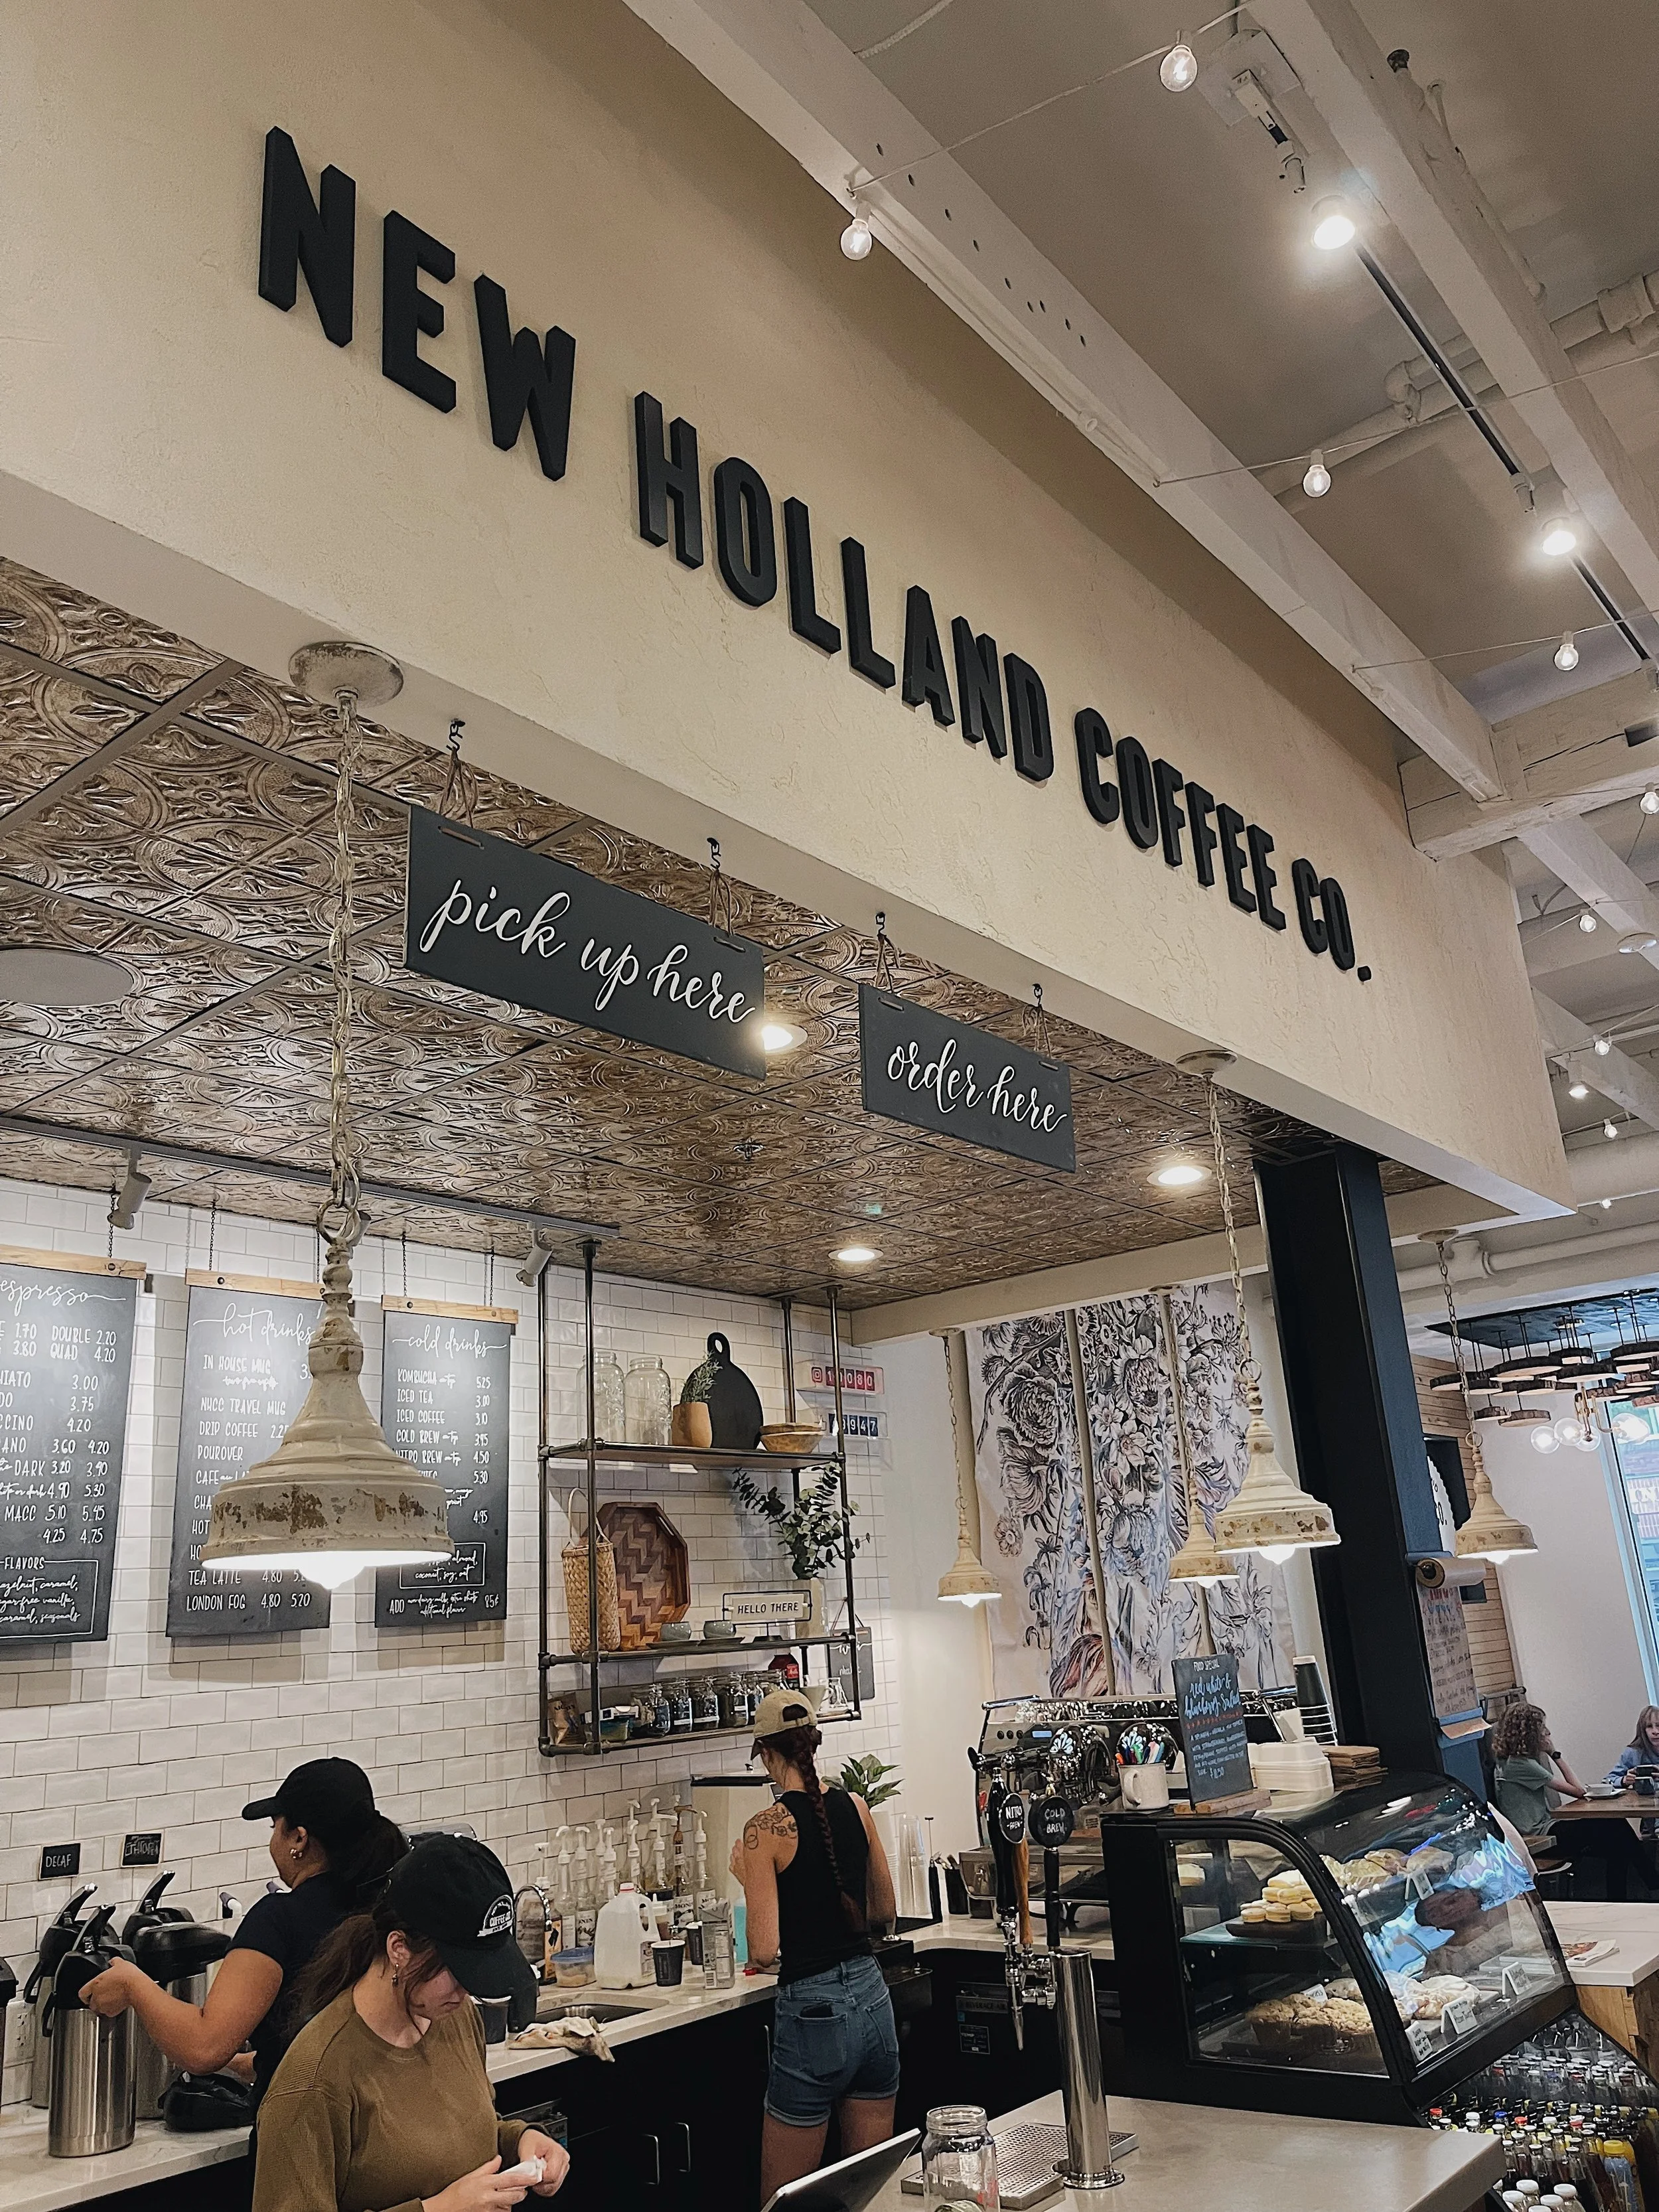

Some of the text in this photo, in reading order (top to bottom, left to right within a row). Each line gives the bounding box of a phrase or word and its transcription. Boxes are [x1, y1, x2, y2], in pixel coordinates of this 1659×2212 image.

[258, 126, 1372, 982] NEW HOLLAND COFFEE CO.
[419, 879, 756, 1023] pick up here
[888, 1039, 1067, 1132] order here
[0, 1280, 126, 1316] espresso
[193, 1302, 316, 1346] hot drinks
[16, 1323, 37, 1339] 1.70
[52, 1325, 91, 1343] DOUBLE
[96, 1330, 116, 1345] 2.20
[392, 1324, 507, 1359] cold drinks
[13, 1341, 36, 1357] 3.80
[50, 1343, 78, 1360] QUAD
[94, 1346, 115, 1363] 4.20
[203, 1355, 311, 1380] IN HOUSE MUG 3.
[72, 1374, 98, 1390] 3.00
[397, 1368, 437, 1385] KOMBUCHA
[70, 1396, 94, 1412] 3.75
[200, 1396, 286, 1416] NHCC TRAVEL MUG
[397, 1388, 490, 1408] ICED TEA 3.00
[396, 1409, 414, 1423] ICED
[418, 1410, 445, 1424] COFFEE
[67, 1418, 91, 1432] 4.20
[199, 1421, 220, 1436] DRIP
[225, 1422, 258, 1438] COFFEE
[396, 1429, 414, 1443] COLD
[419, 1430, 440, 1444] BREW
[52, 1439, 76, 1453] 3.60
[88, 1439, 109, 1455] 4.20
[198, 1445, 244, 1461] POUROVER
[422, 1450, 443, 1464] BREW
[473, 1450, 490, 1464] 4.50
[15, 1460, 45, 1476] DARK
[51, 1460, 71, 1474] 3.20
[196, 1470, 219, 1485] CAFE
[473, 1471, 489, 1484] 5.30
[47, 1481, 70, 1499] 4.90
[84, 1483, 105, 1497] 5.30
[194, 1495, 212, 1511] CHA
[5, 1505, 36, 1522] MACC
[45, 1504, 66, 1521] 5.10
[43, 1527, 104, 1544] 4.25 4.75
[5, 1557, 44, 1570] FLAVORS
[188, 1570, 207, 1585] TEA
[212, 1570, 242, 1585] LATTE
[261, 1570, 283, 1583] 4.80
[186, 1592, 311, 1611] LONDON FOG 4.80 5.20
[390, 1599, 405, 1614] ADD
[737, 1601, 798, 1614] HELLO THERE
[1005, 1806, 1022, 1819] NITRO
[1045, 1808, 1066, 1820] COLD
[46, 1854, 72, 1868] DECAF
